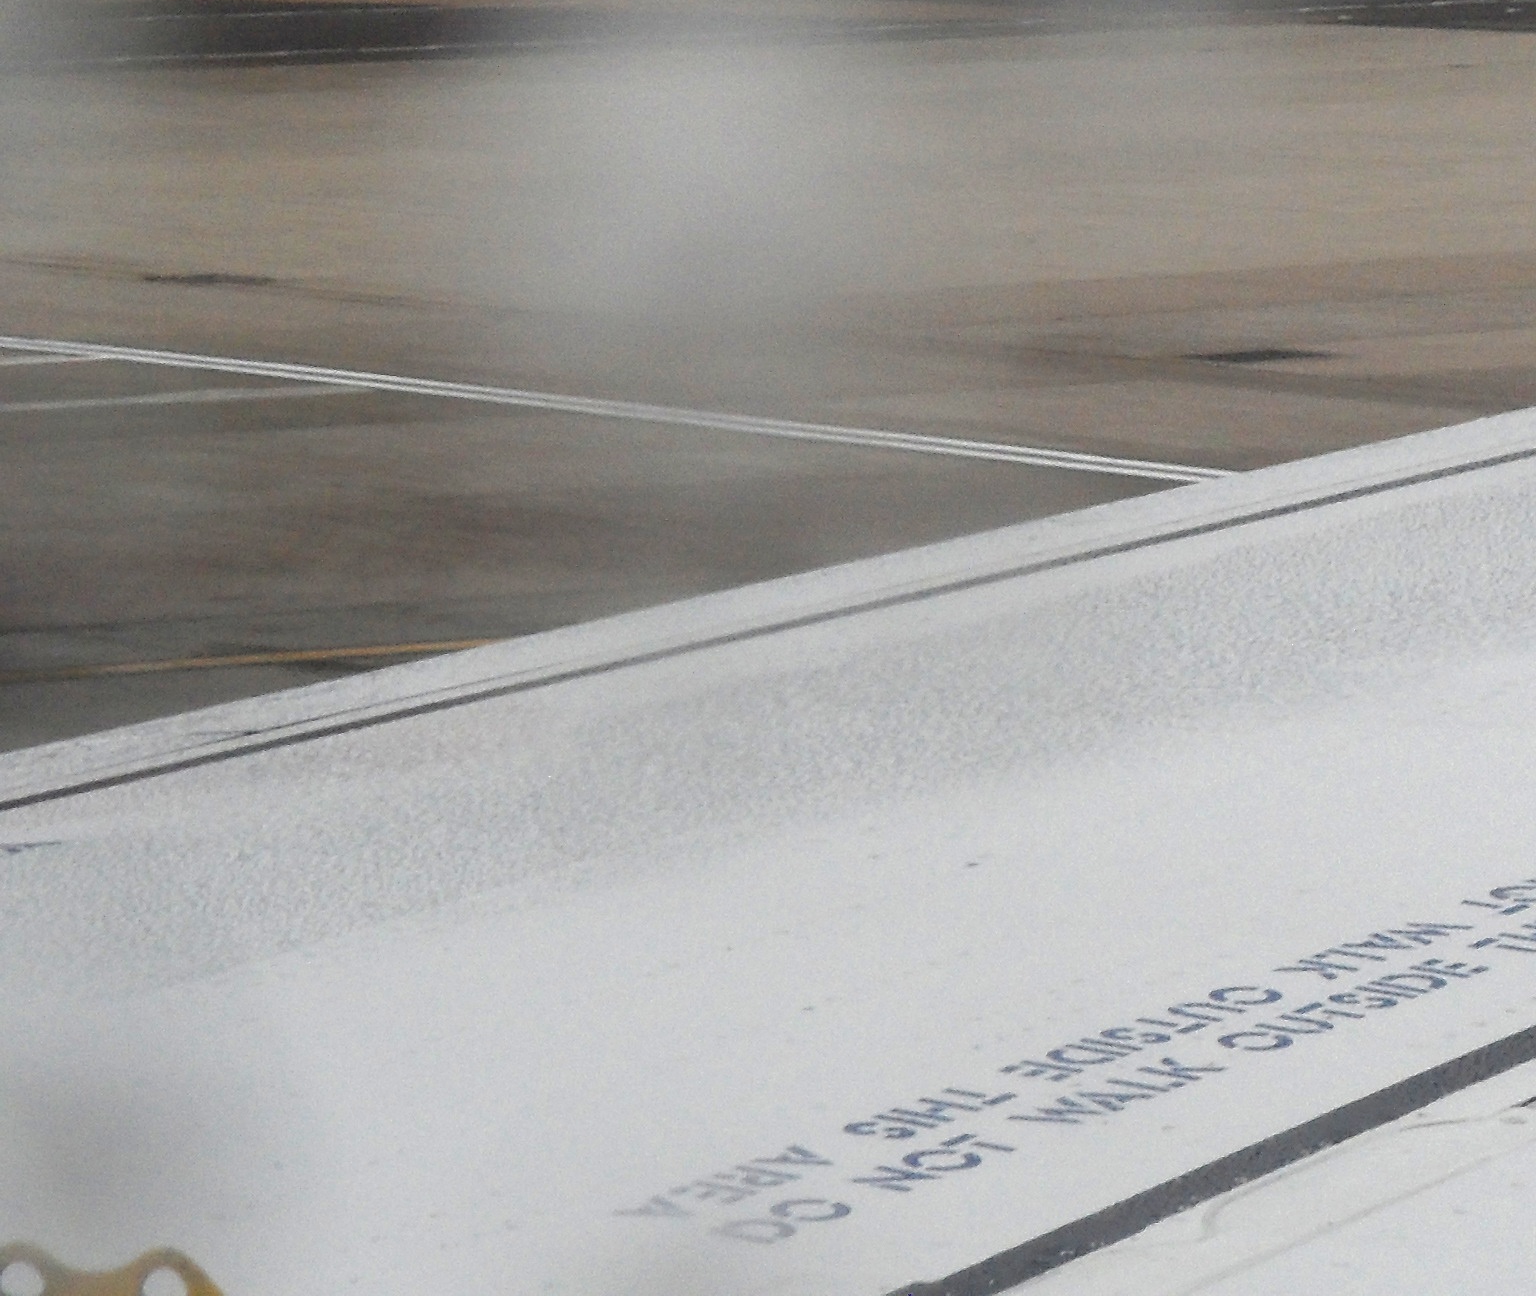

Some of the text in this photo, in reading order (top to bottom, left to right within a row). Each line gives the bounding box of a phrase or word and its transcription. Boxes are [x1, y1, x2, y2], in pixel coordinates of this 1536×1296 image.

[1274, 920, 1474, 980] WALK
[999, 985, 1283, 1083] OUTSIDE
[708, 1198, 853, 1245] DO
[852, 1132, 1017, 1193] NOT
[1007, 1056, 1227, 1125] WALK
[1216, 957, 1490, 1052] OUTSIDE
[842, 1087, 1018, 1140] THIS
[613, 1144, 834, 1221] AREA
